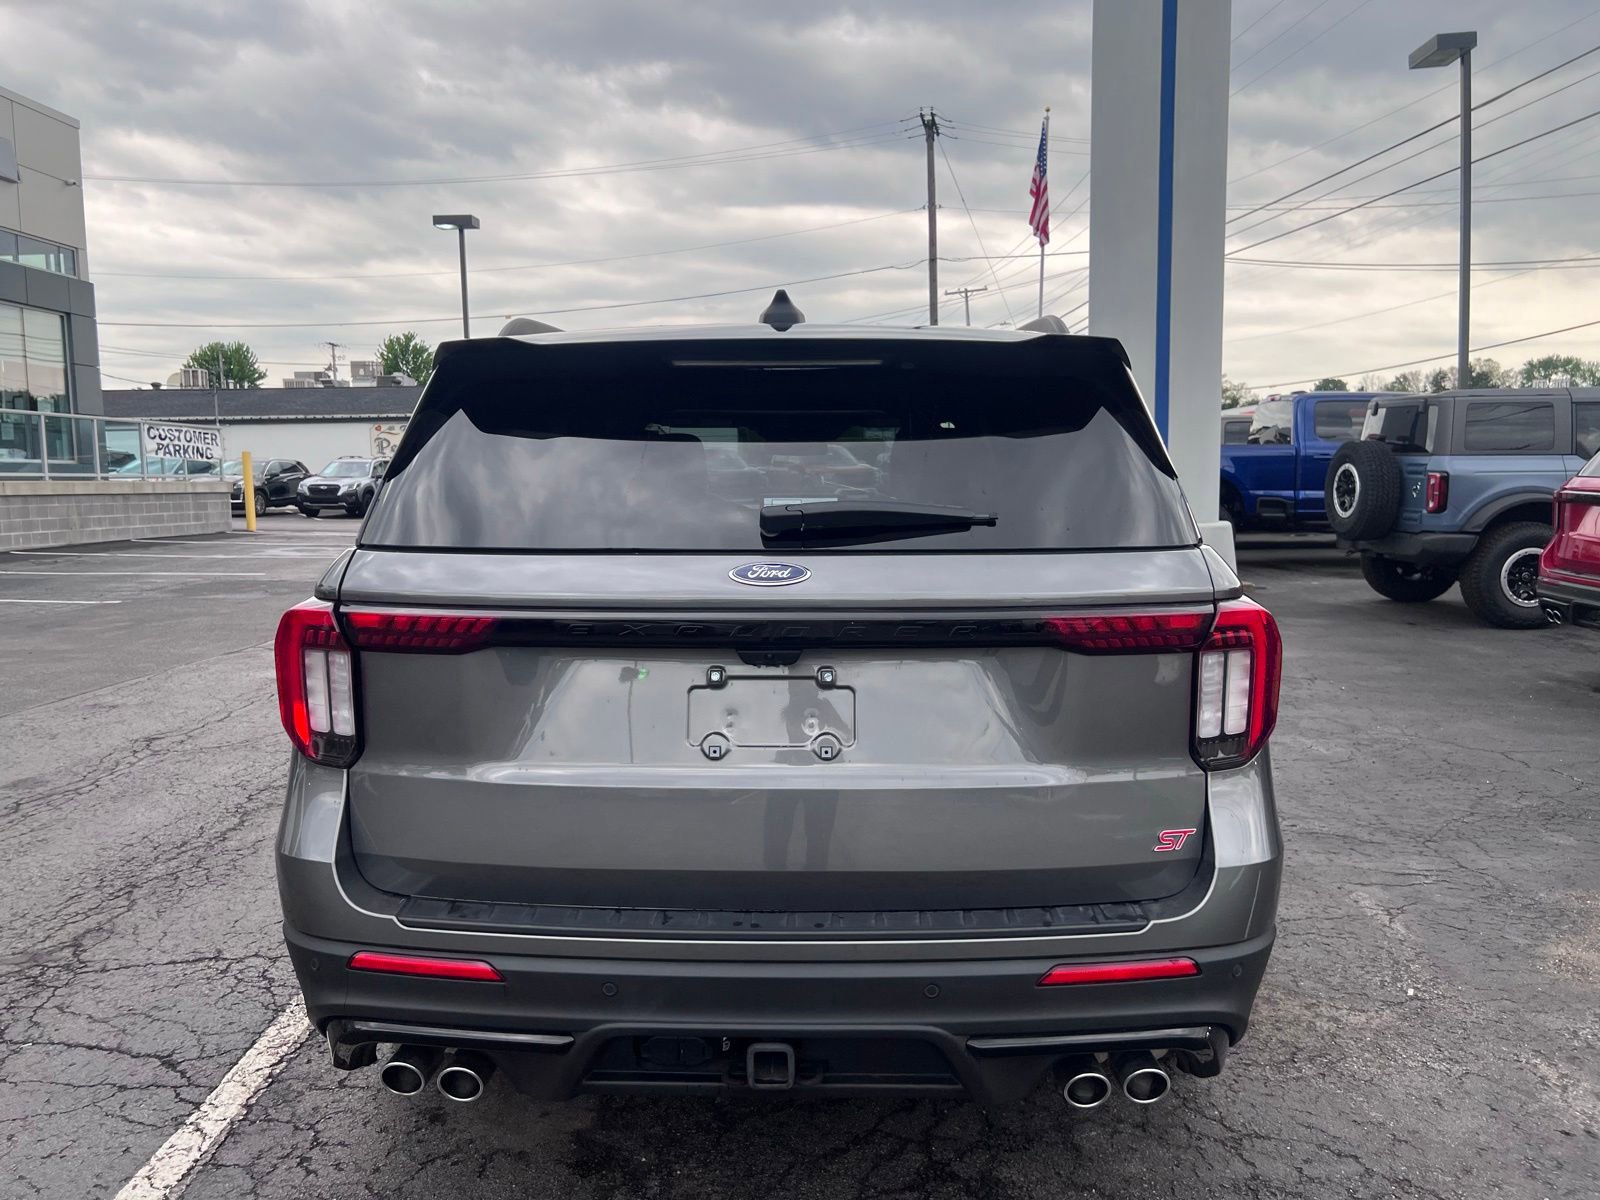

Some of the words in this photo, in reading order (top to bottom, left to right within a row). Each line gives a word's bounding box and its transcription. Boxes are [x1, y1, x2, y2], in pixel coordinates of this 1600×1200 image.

[147, 426, 219, 447] CUSTOMER
[155, 442, 214, 460] PARKING
[747, 564, 792, 578] Ford
[568, 622, 979, 639] EXPLORER
[1154, 828, 1197, 852] ST
